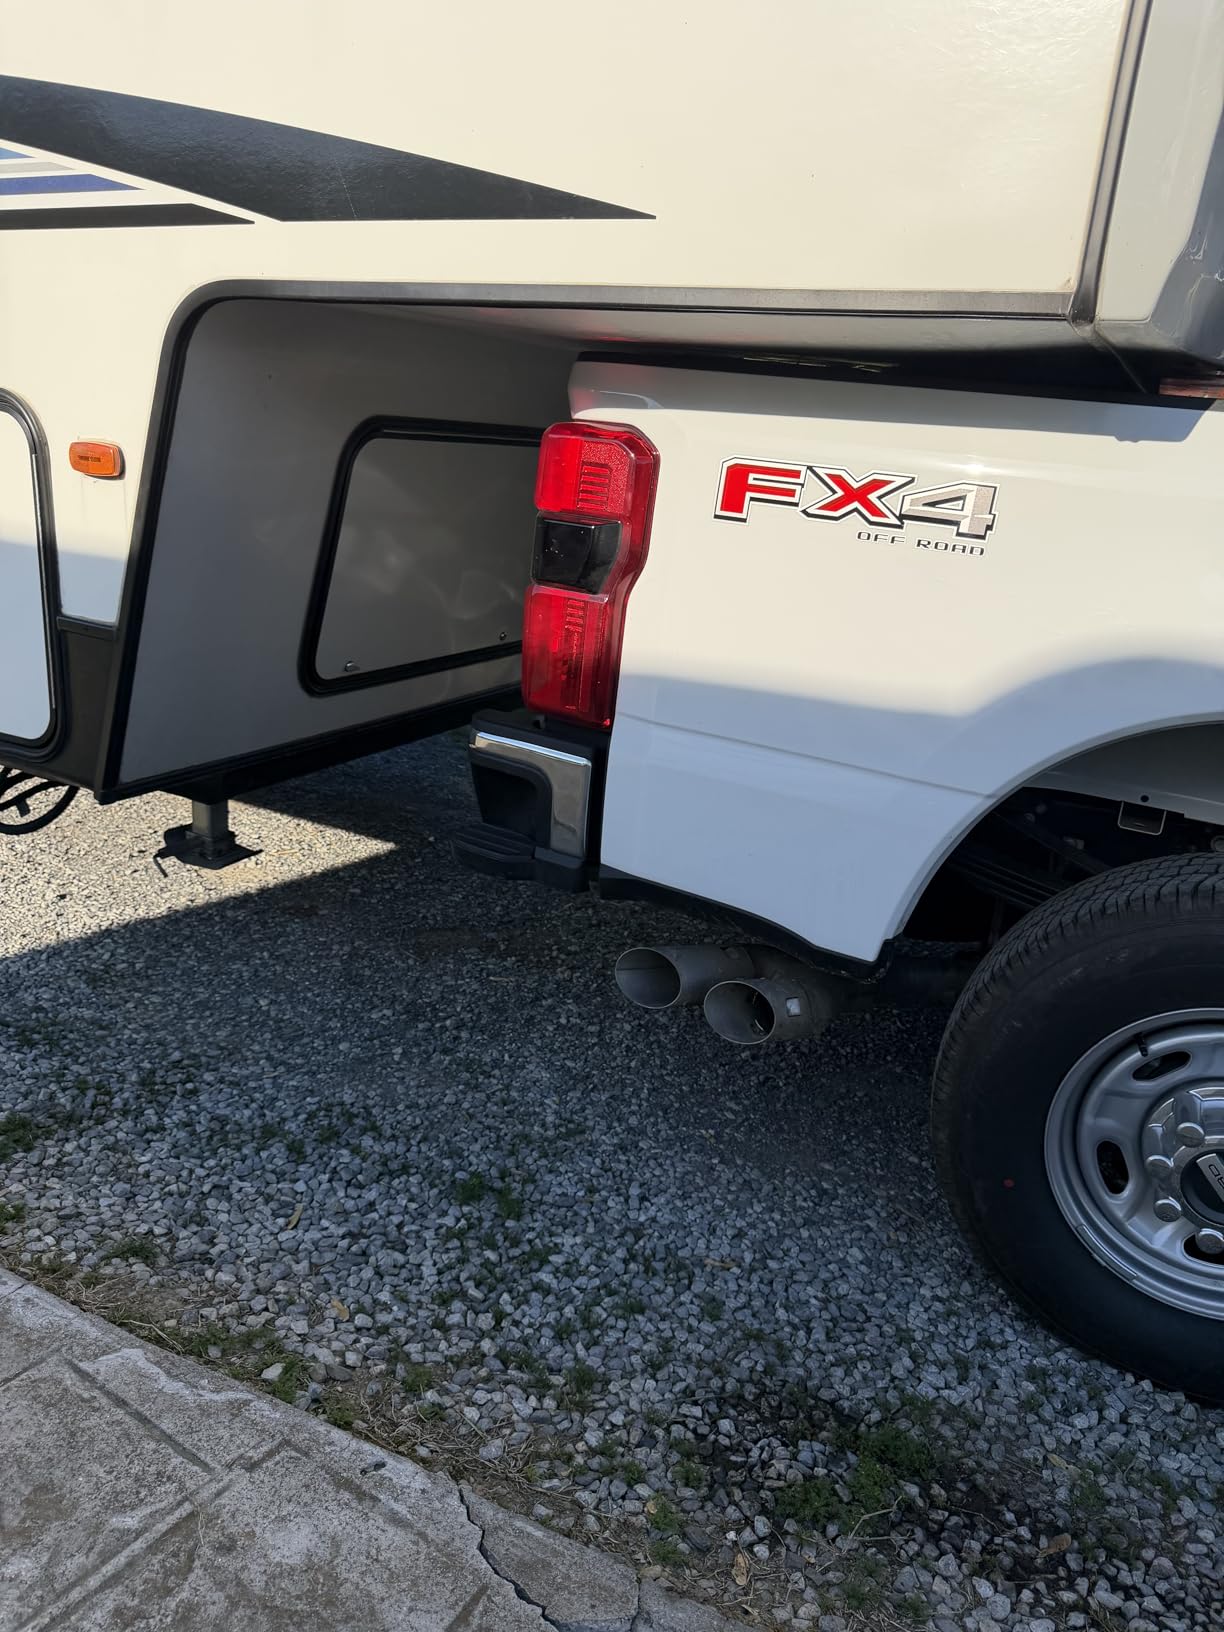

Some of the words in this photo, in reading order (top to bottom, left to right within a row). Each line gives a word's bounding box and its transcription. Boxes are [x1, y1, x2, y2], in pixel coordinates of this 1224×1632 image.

[713, 456, 998, 541] FX4
[857, 531, 905, 545] OFF
[916, 538, 985, 557] ROAD
